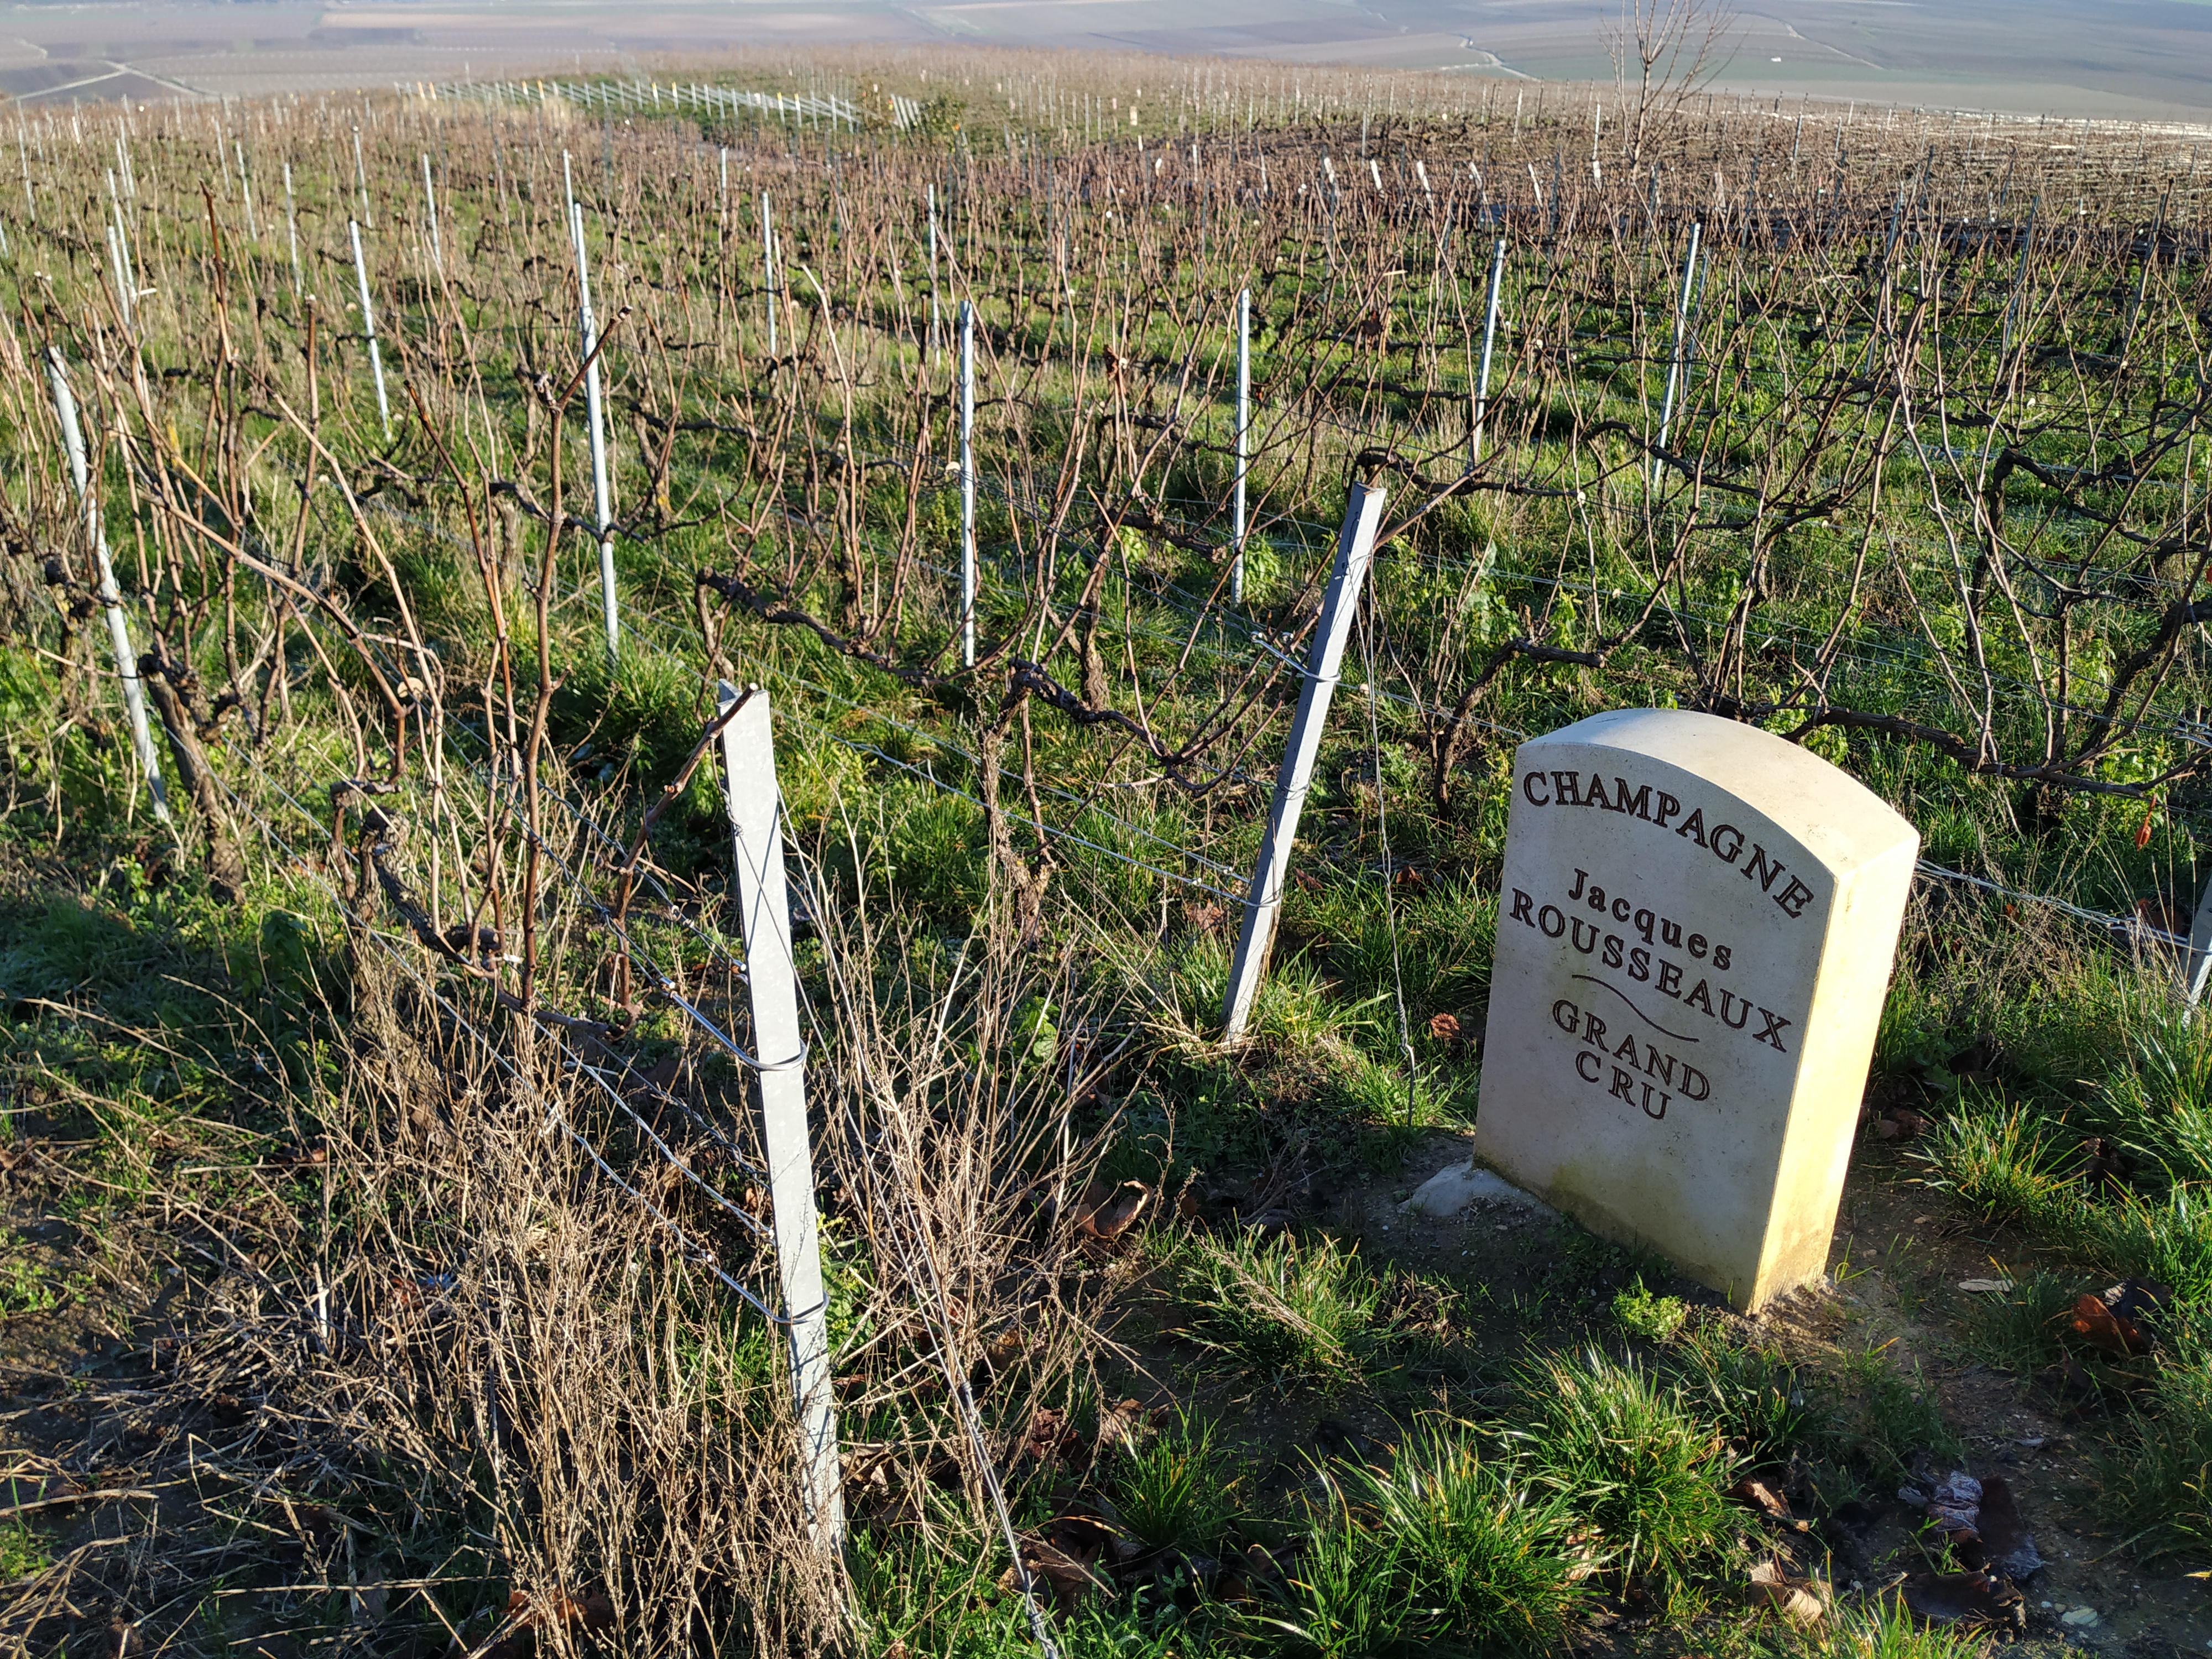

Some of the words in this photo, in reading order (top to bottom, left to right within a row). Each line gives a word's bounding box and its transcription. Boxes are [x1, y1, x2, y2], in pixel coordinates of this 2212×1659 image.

[1524, 771, 1814, 918] CHAMPAGNE
[1510, 888, 1792, 1053] ROUSSEAUX
[1568, 868, 1731, 970] Jacques
[1552, 999, 1710, 1102] GRAND
[1576, 1051, 1671, 1120] CRU
